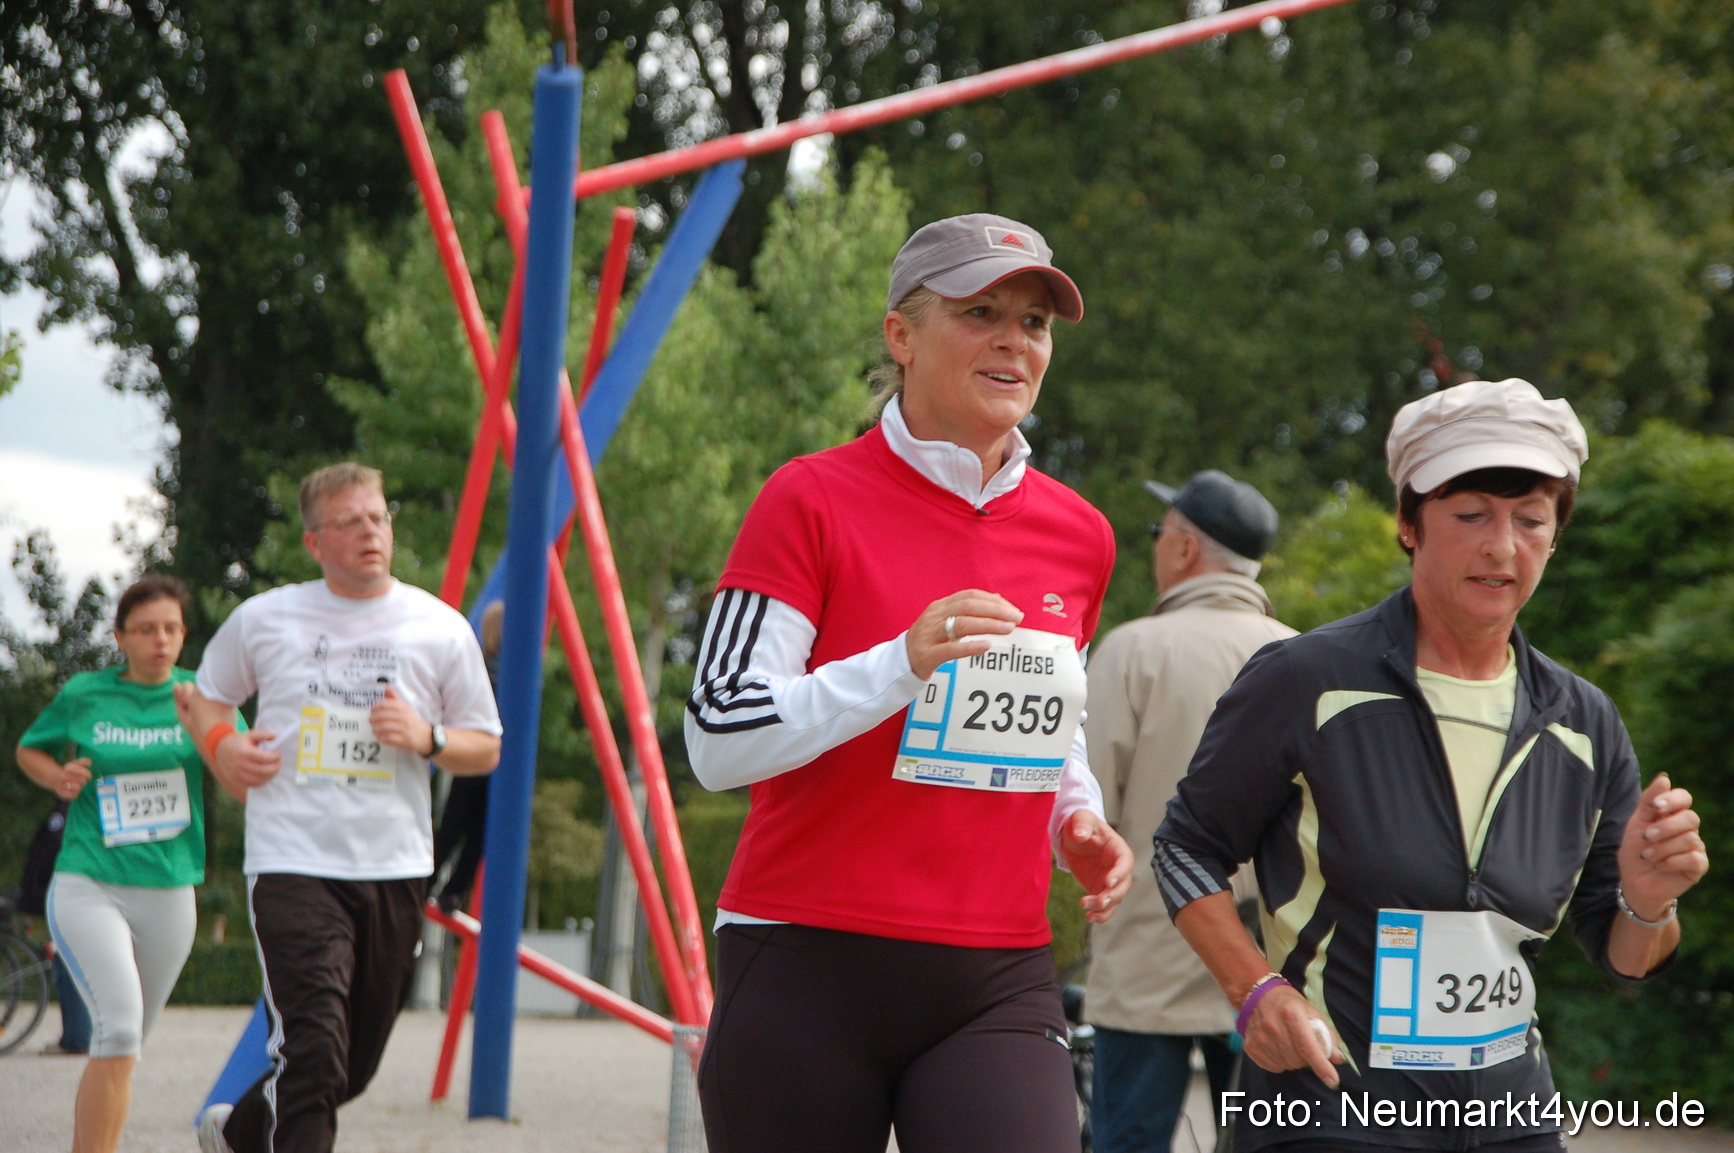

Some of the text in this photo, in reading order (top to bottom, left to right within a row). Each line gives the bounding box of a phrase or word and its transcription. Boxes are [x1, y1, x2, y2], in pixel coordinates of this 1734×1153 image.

[969, 644, 1055, 675] Marliese
[925, 683, 937, 704] D
[962, 690, 1064, 735] 2359
[93, 721, 183, 750] Sinupret
[338, 739, 382, 764] 152
[128, 793, 178, 818] 2237
[1436, 966, 1523, 1013] 3249
